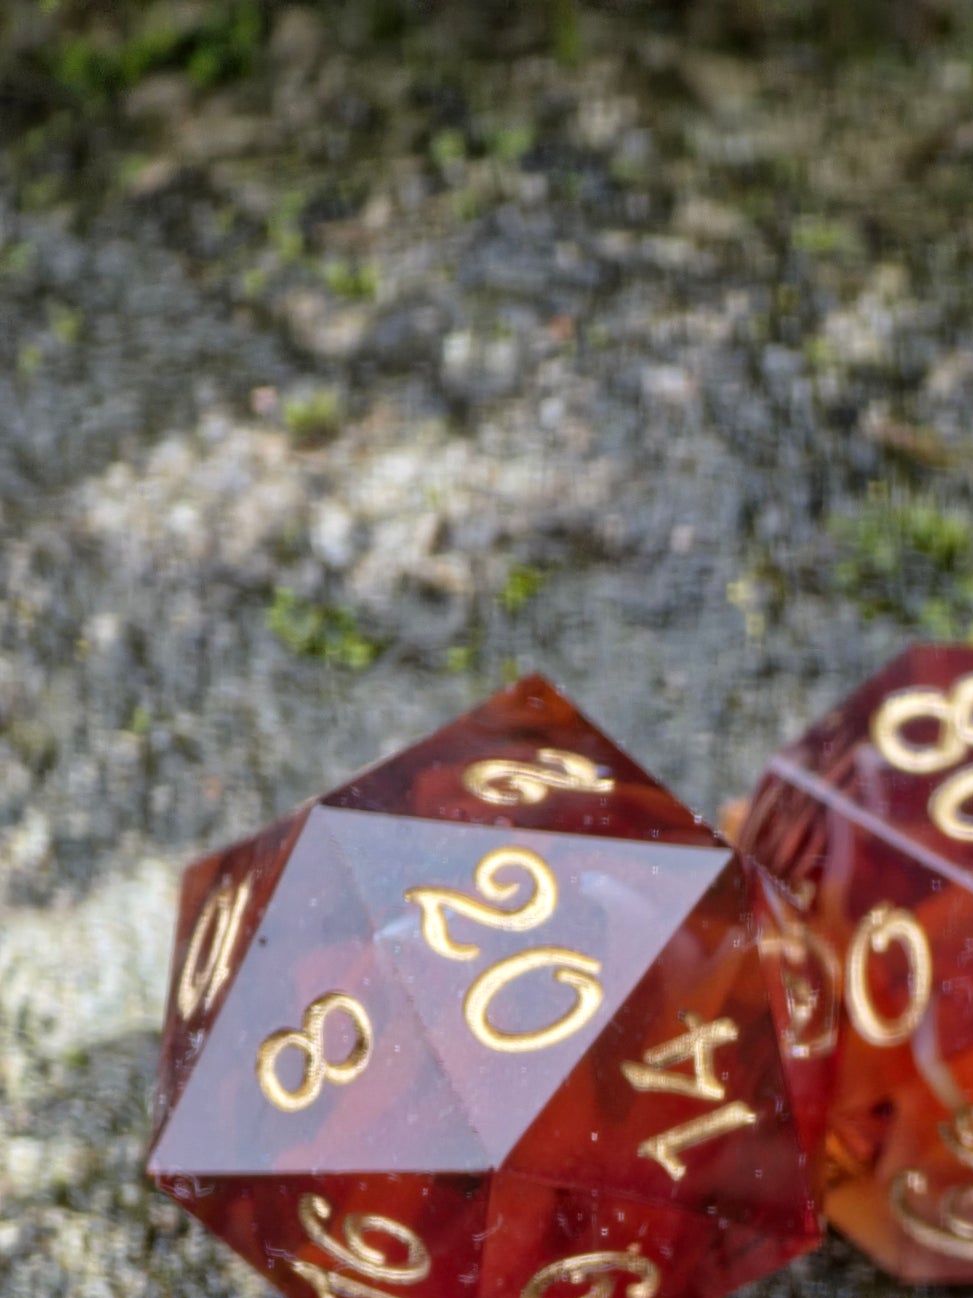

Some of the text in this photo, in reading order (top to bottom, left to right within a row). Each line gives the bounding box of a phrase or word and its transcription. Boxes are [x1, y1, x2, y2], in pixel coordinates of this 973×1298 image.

[464, 747, 615, 804] 2
[405, 846, 603, 1053] 20
[256, 991, 374, 1112] 8
[621, 1010, 756, 1182] 14
